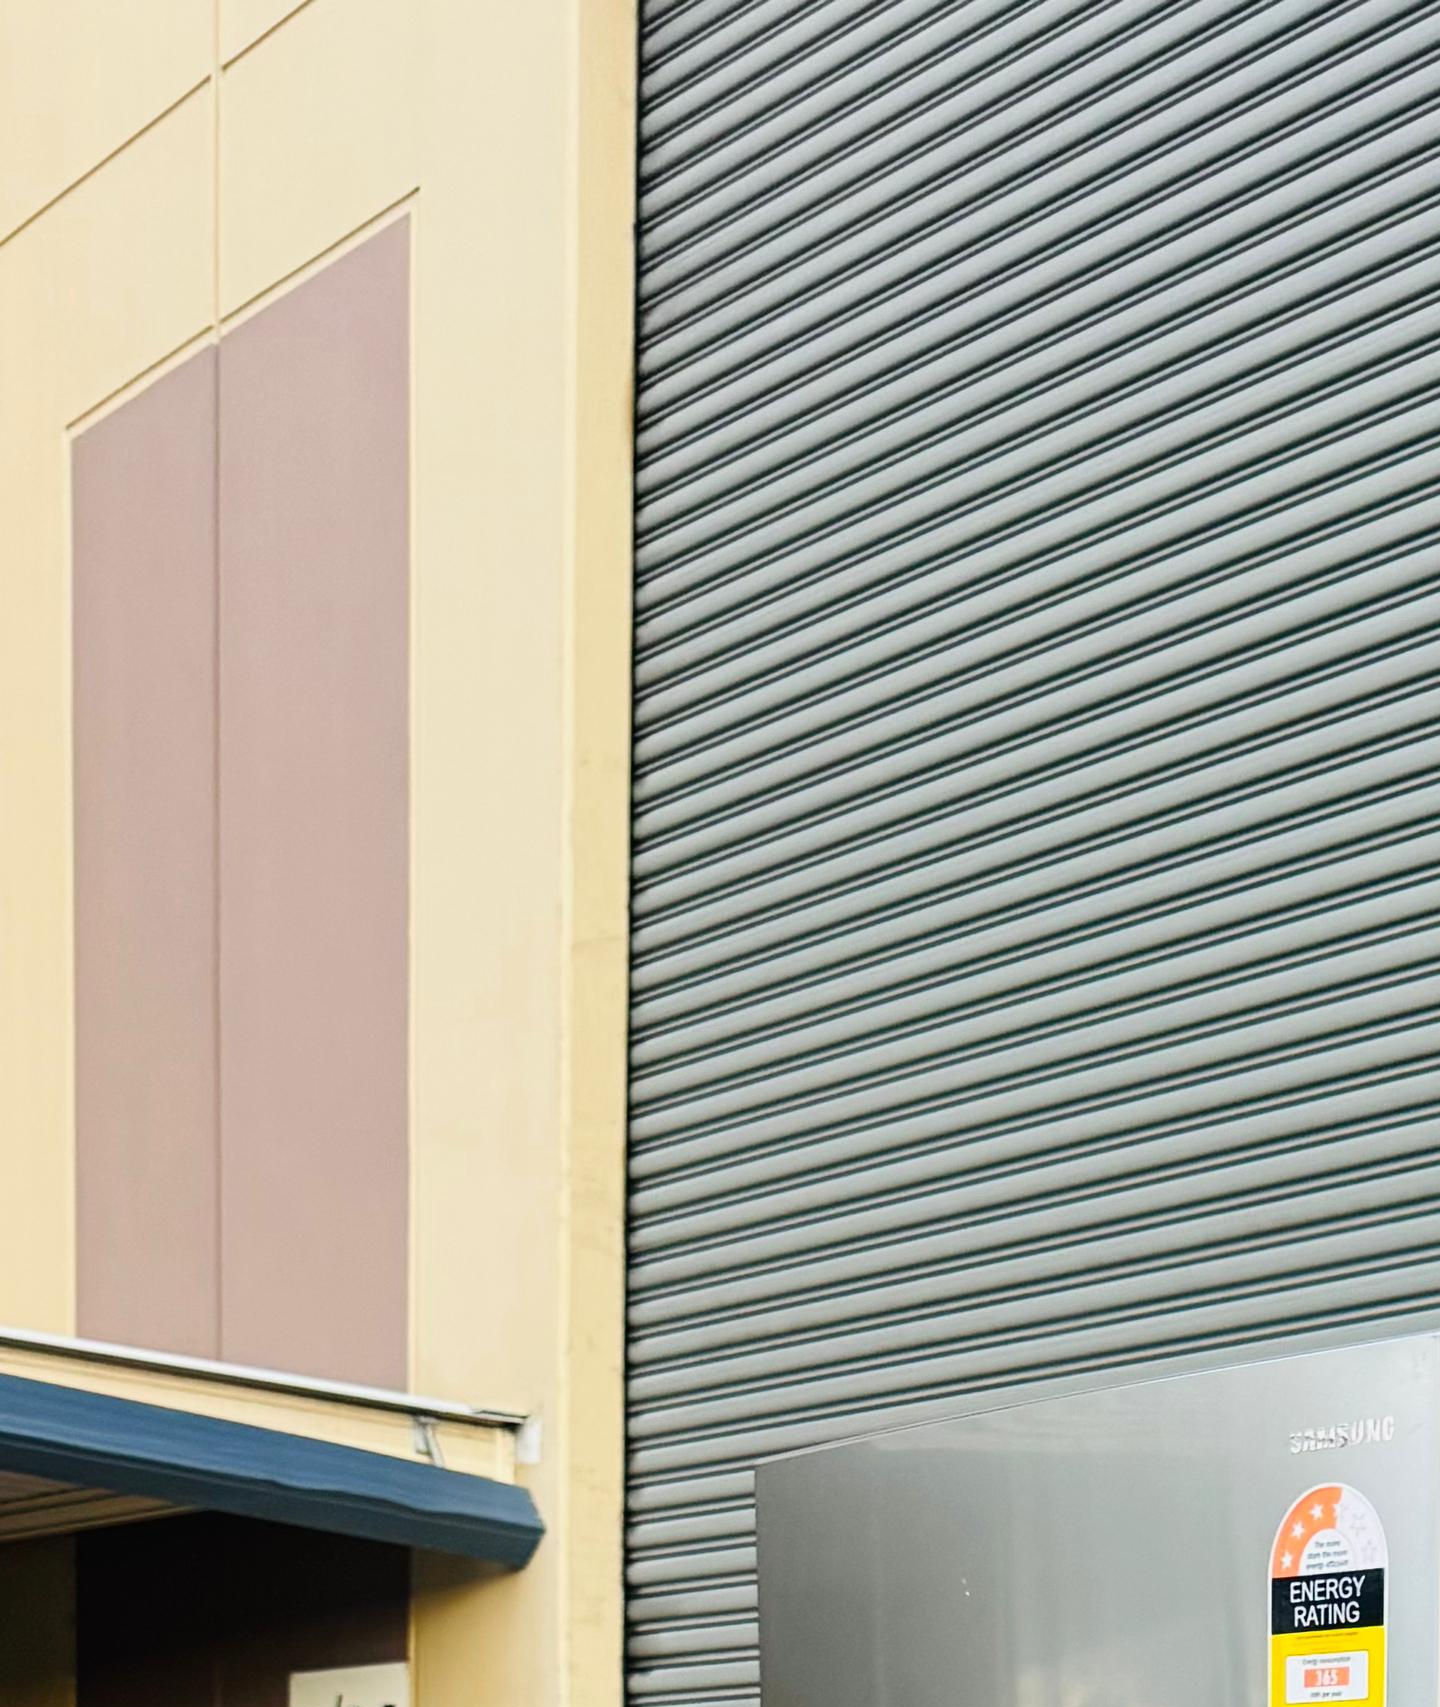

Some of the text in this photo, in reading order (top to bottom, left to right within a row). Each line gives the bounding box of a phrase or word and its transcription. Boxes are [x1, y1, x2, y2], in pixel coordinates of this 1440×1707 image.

[1289, 1416, 1394, 1454] SAMSUNG
[1290, 1575, 1365, 1603] ENERGY
[1294, 1601, 1360, 1627] RATING
[1315, 1668, 1338, 1686] 365
